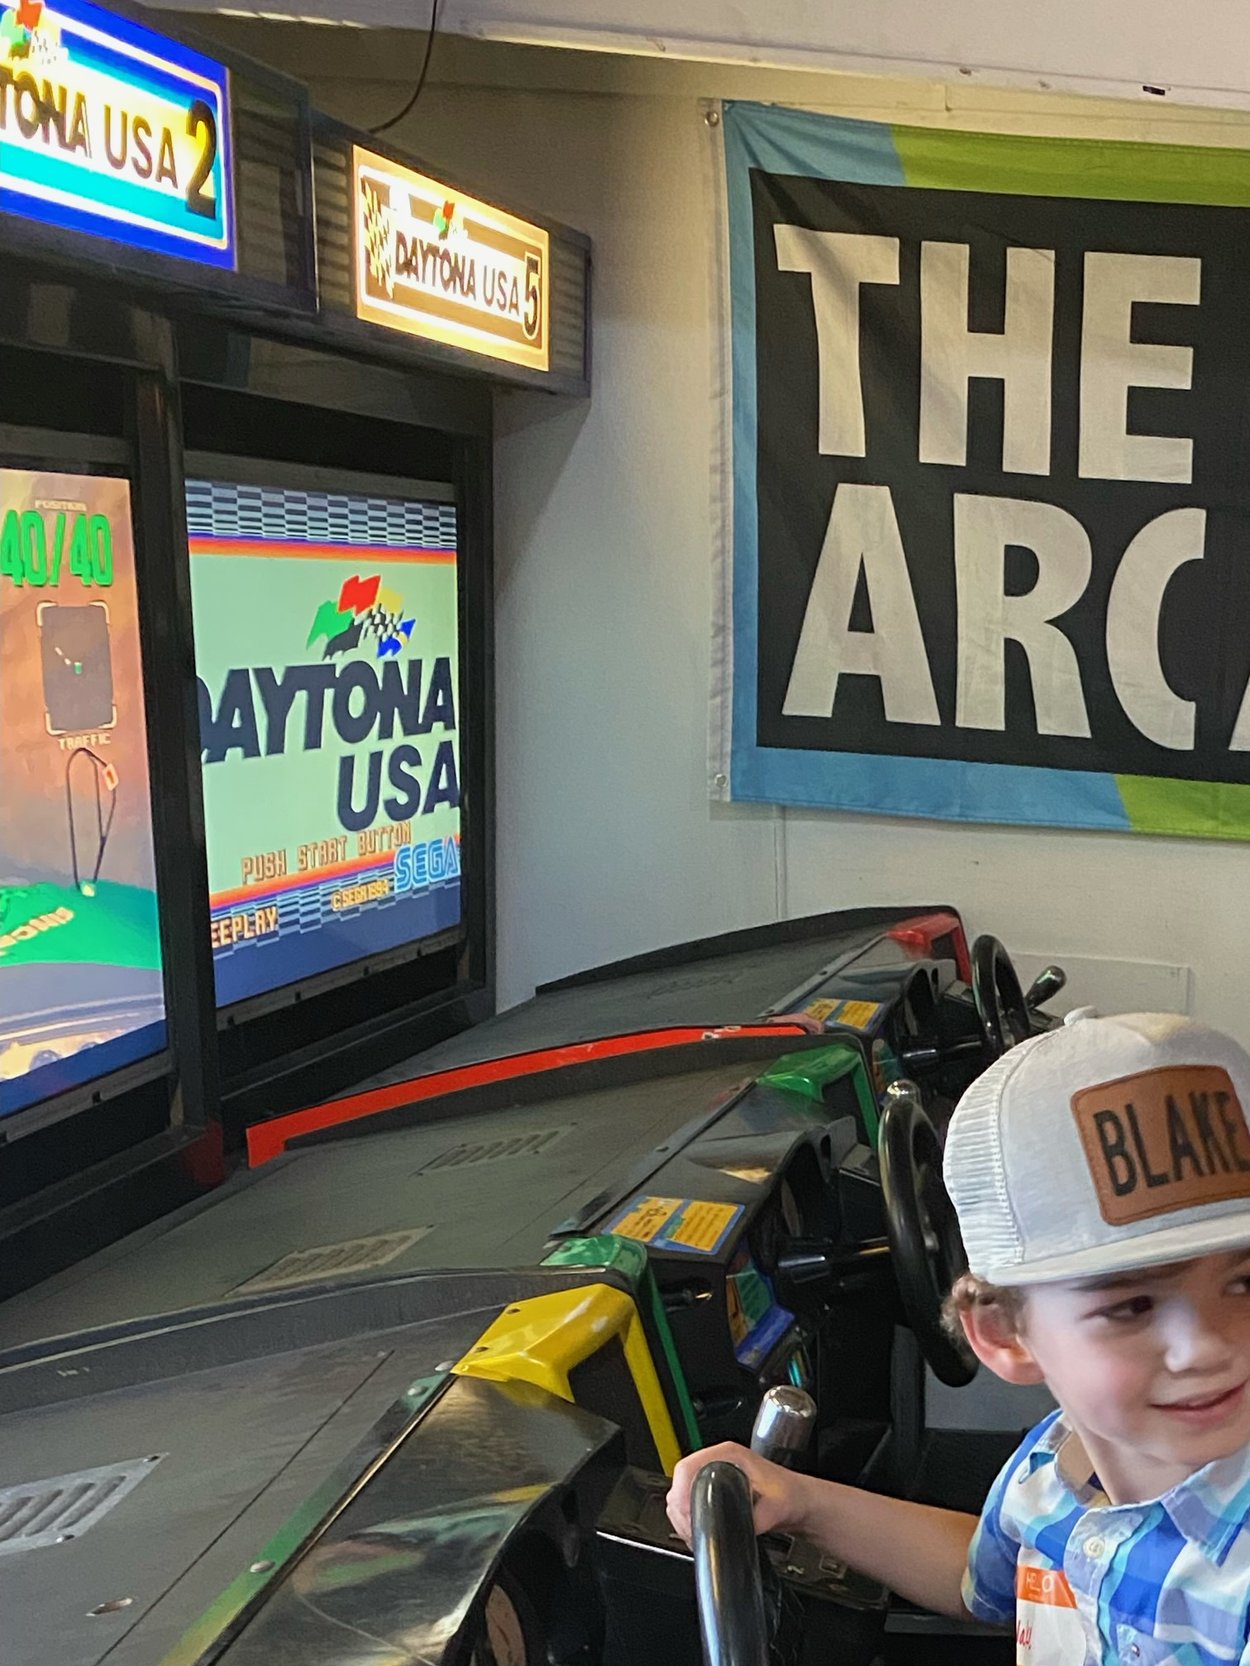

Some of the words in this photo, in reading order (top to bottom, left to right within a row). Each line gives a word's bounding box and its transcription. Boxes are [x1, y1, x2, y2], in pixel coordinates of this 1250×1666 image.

[103, 103, 179, 189] USA
[185, 99, 217, 220] 2
[395, 230, 477, 300] DAYTONA
[483, 264, 520, 316] USA
[523, 254, 540, 339] 5
[774, 222, 1202, 487] THE
[0, 508, 113, 588] 40/40
[57, 731, 111, 750] TRAFFIC
[337, 740, 460, 832] USA
[241, 848, 287, 886] PUSH
[297, 835, 348, 872] START
[357, 821, 412, 856] BUTTON
[394, 835, 461, 893] SEGA
